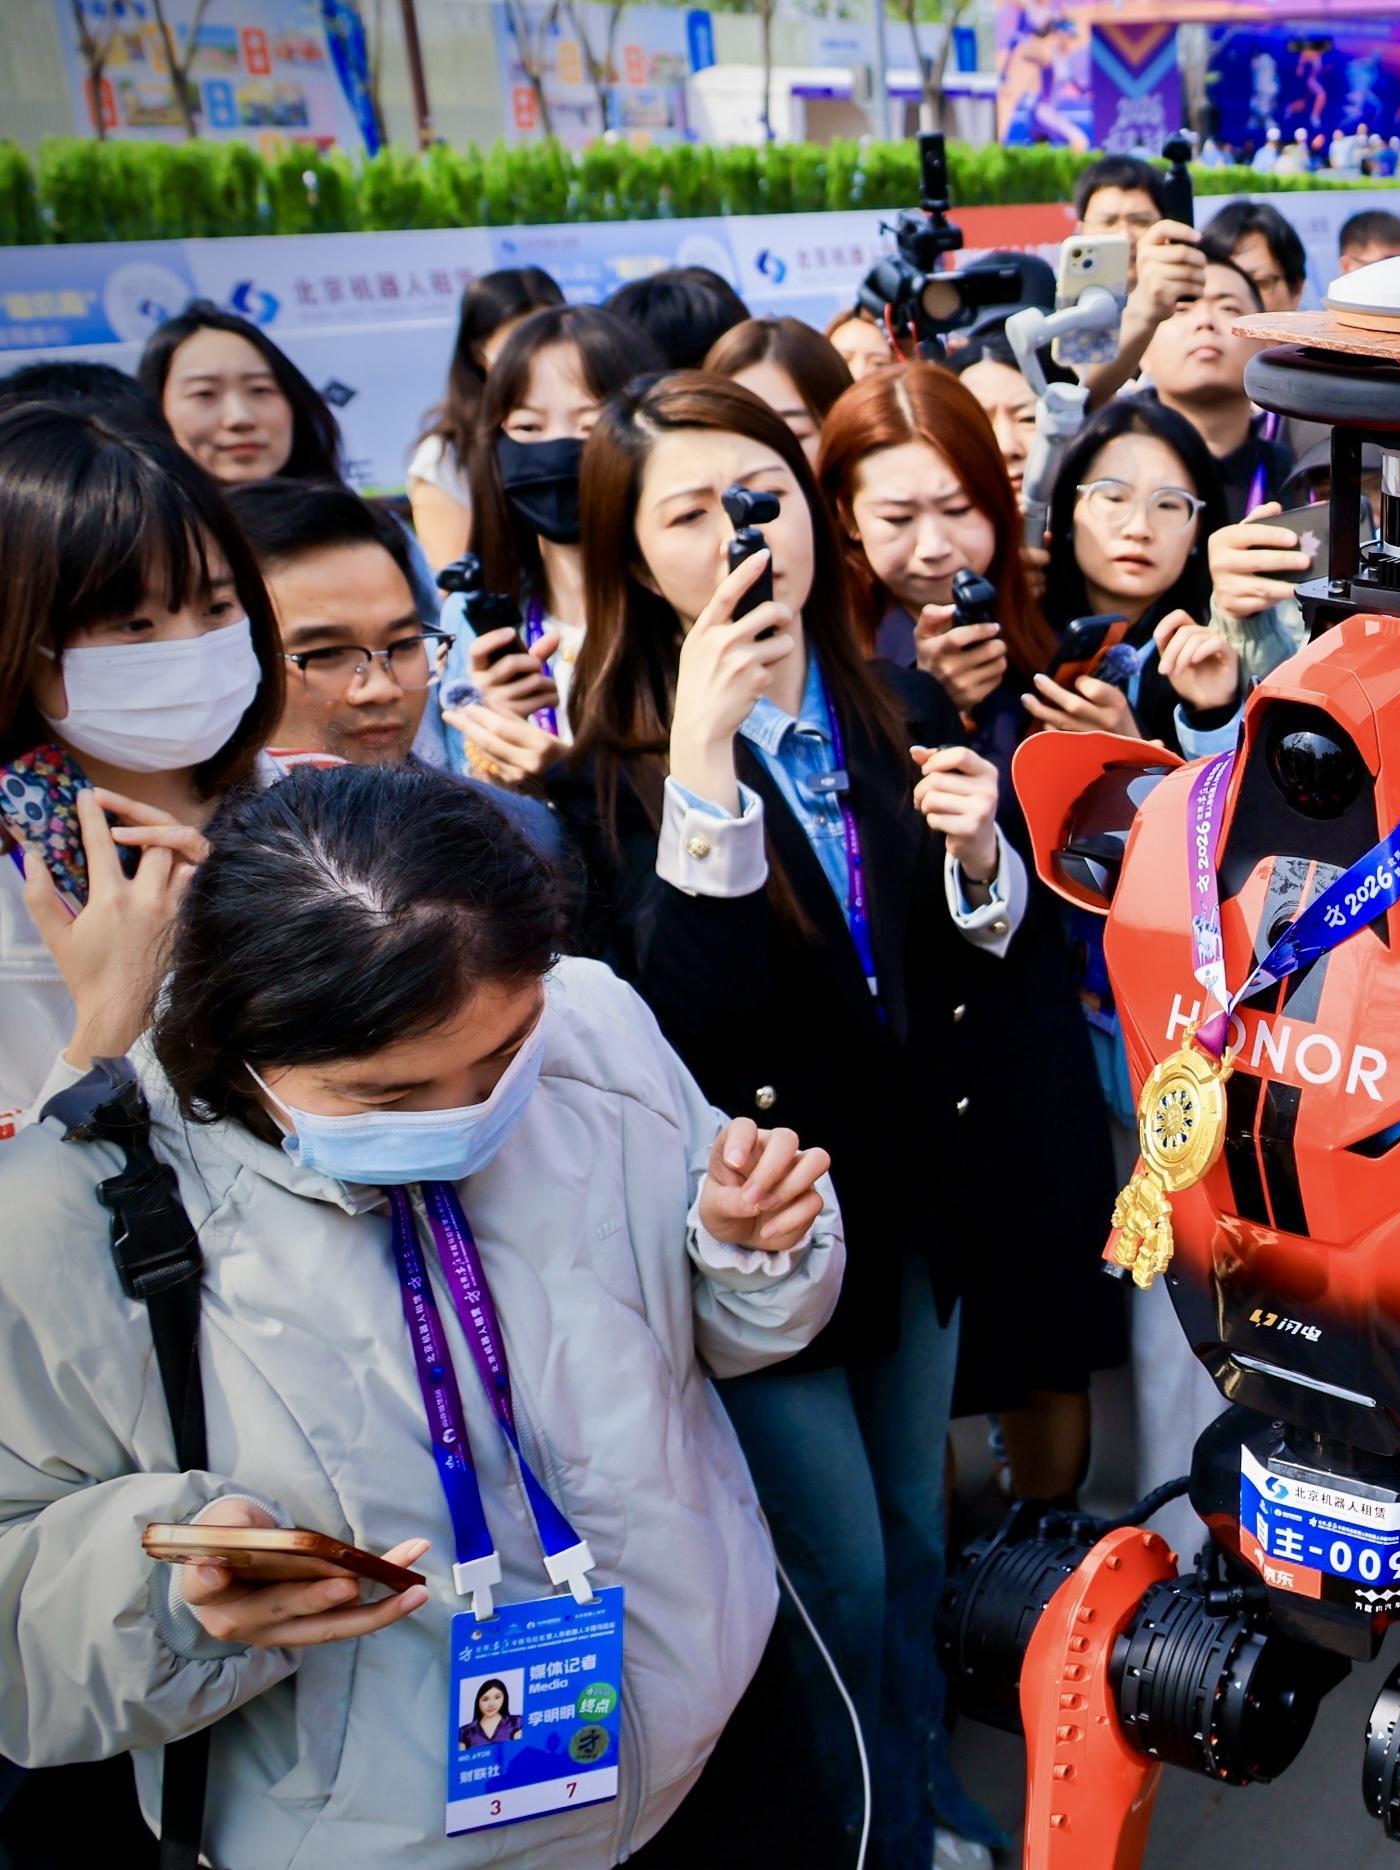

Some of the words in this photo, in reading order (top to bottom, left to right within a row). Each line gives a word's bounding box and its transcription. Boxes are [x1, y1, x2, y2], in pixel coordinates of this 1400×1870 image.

[1196, 821, 1211, 869] 2026
[1345, 866, 1393, 916] 2026
[412, 1294, 436, 1364] 北京机器人租赁
[470, 1307, 499, 1373] 北京机器人租赁
[1277, 1317, 1322, 1342] 闪电
[1294, 1486, 1387, 1520] 北京机器人租赁
[529, 1653, 598, 1681] 媒体记者
[528, 1678, 568, 1694] Media
[527, 1703, 576, 1727] 李明明
[578, 1698, 611, 1714] 终点
[459, 1764, 501, 1784] 财联社
[490, 1799, 502, 1816] 3
[566, 1782, 577, 1799] 7
